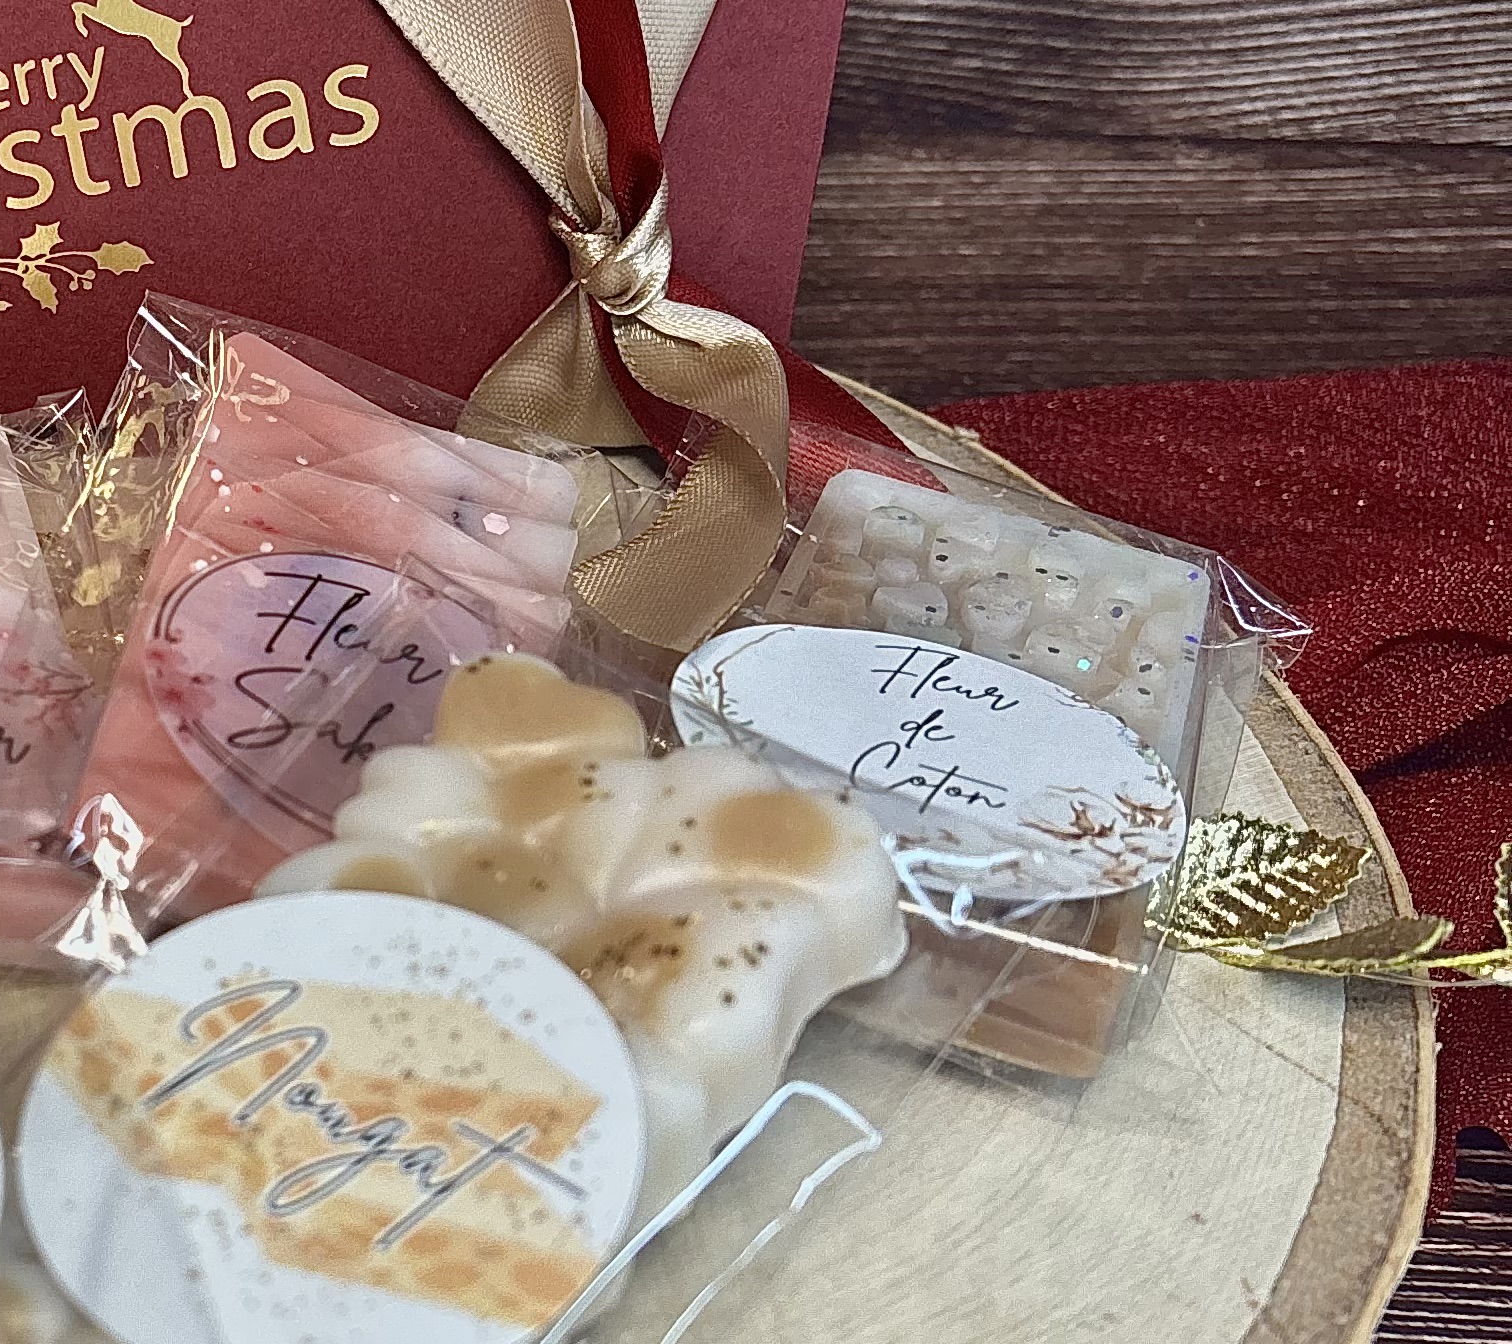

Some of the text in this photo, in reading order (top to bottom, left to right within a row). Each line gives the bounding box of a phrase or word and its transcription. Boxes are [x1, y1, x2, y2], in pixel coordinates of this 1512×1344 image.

[871, 645, 1019, 711] Fleur
[899, 709, 956, 749] de
[849, 741, 1009, 815] Coton
[142, 980, 589, 1251] Nougat
